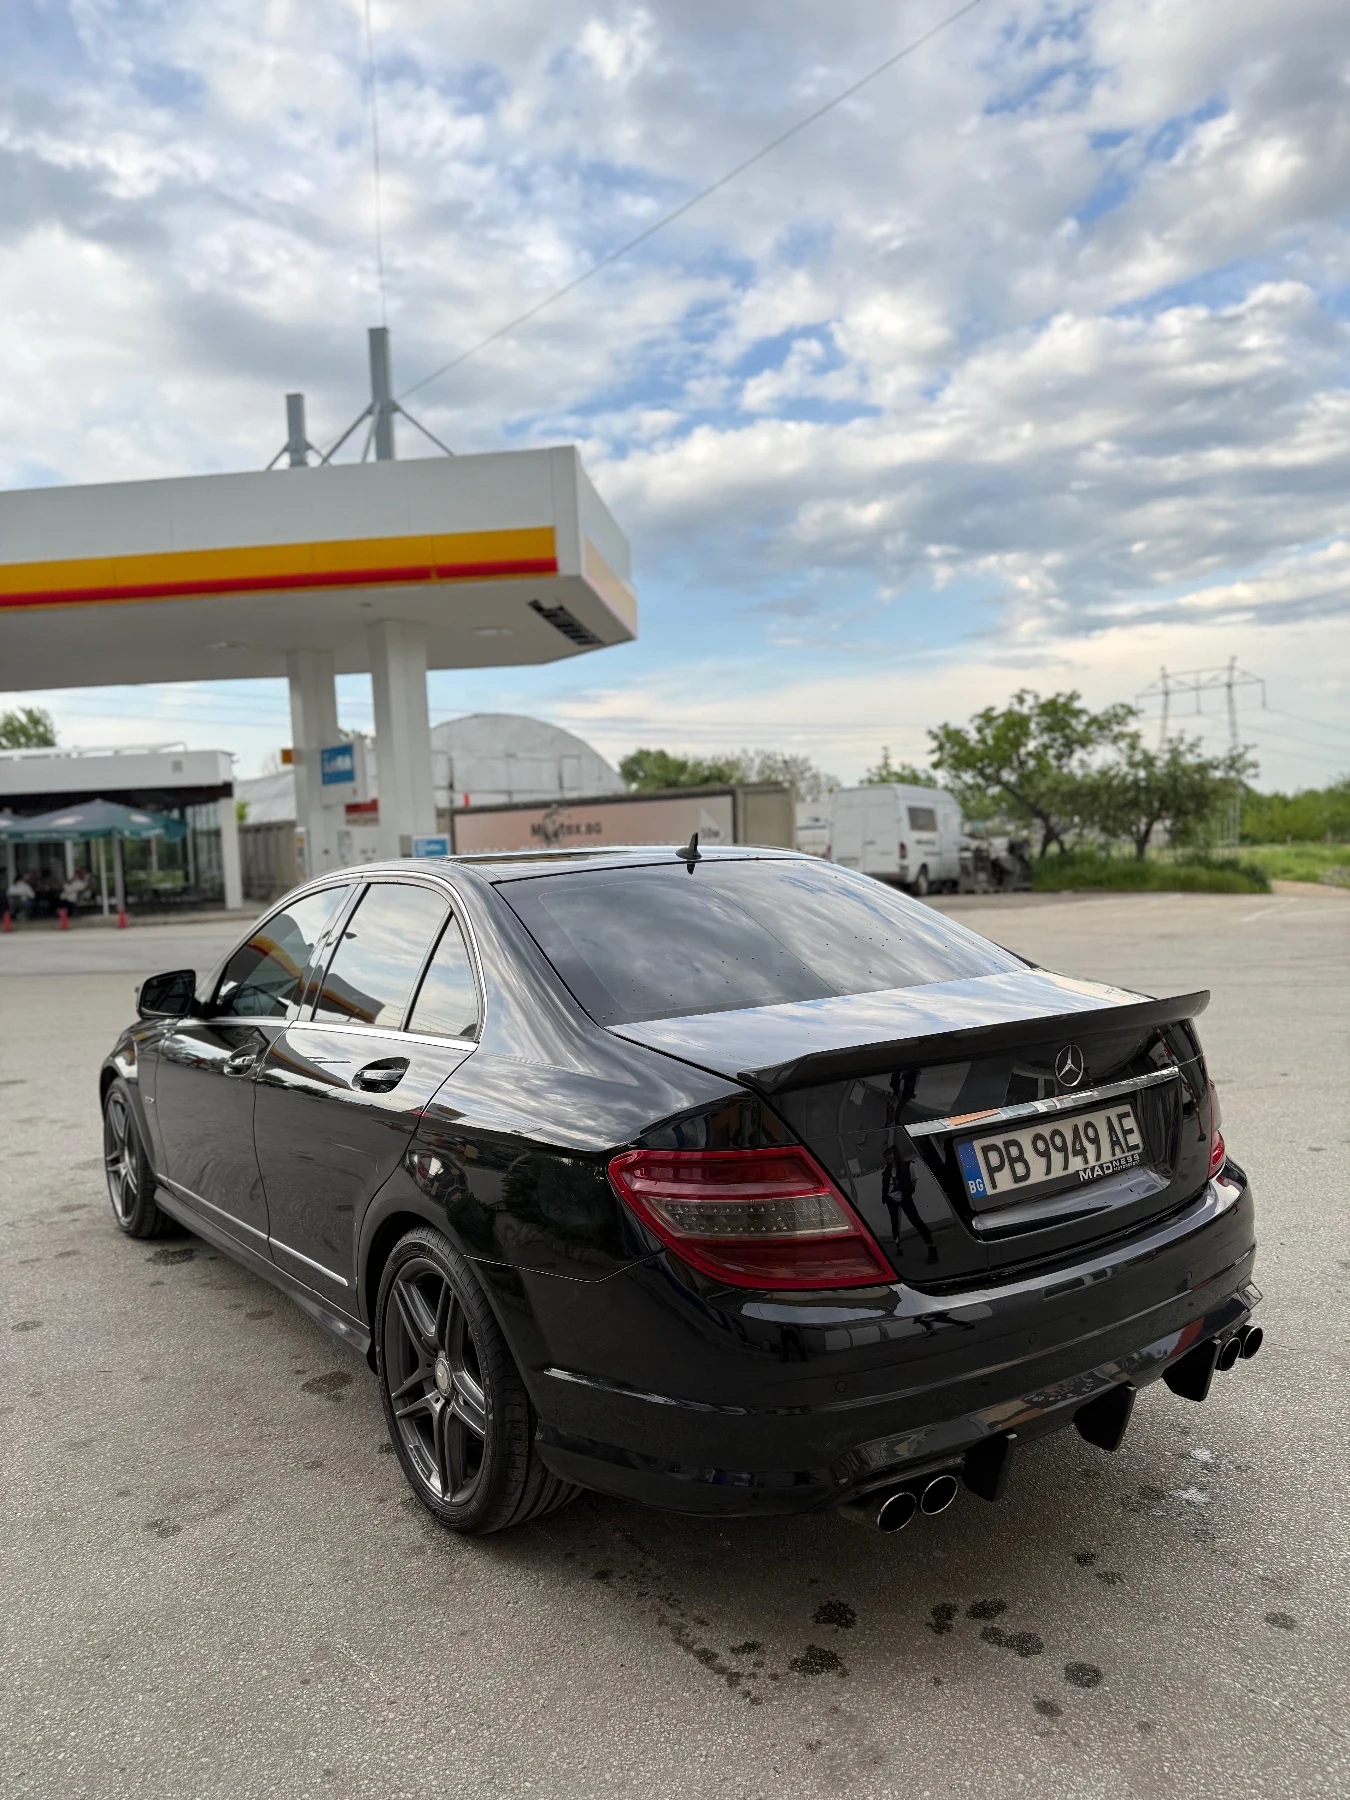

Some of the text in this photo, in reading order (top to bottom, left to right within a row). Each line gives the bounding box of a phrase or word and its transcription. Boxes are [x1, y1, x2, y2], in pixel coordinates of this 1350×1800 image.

[980, 1111, 1141, 1190] PB 9949 AE
[1078, 1153, 1140, 1182] MADNESS
[967, 1179, 984, 1194] BG
